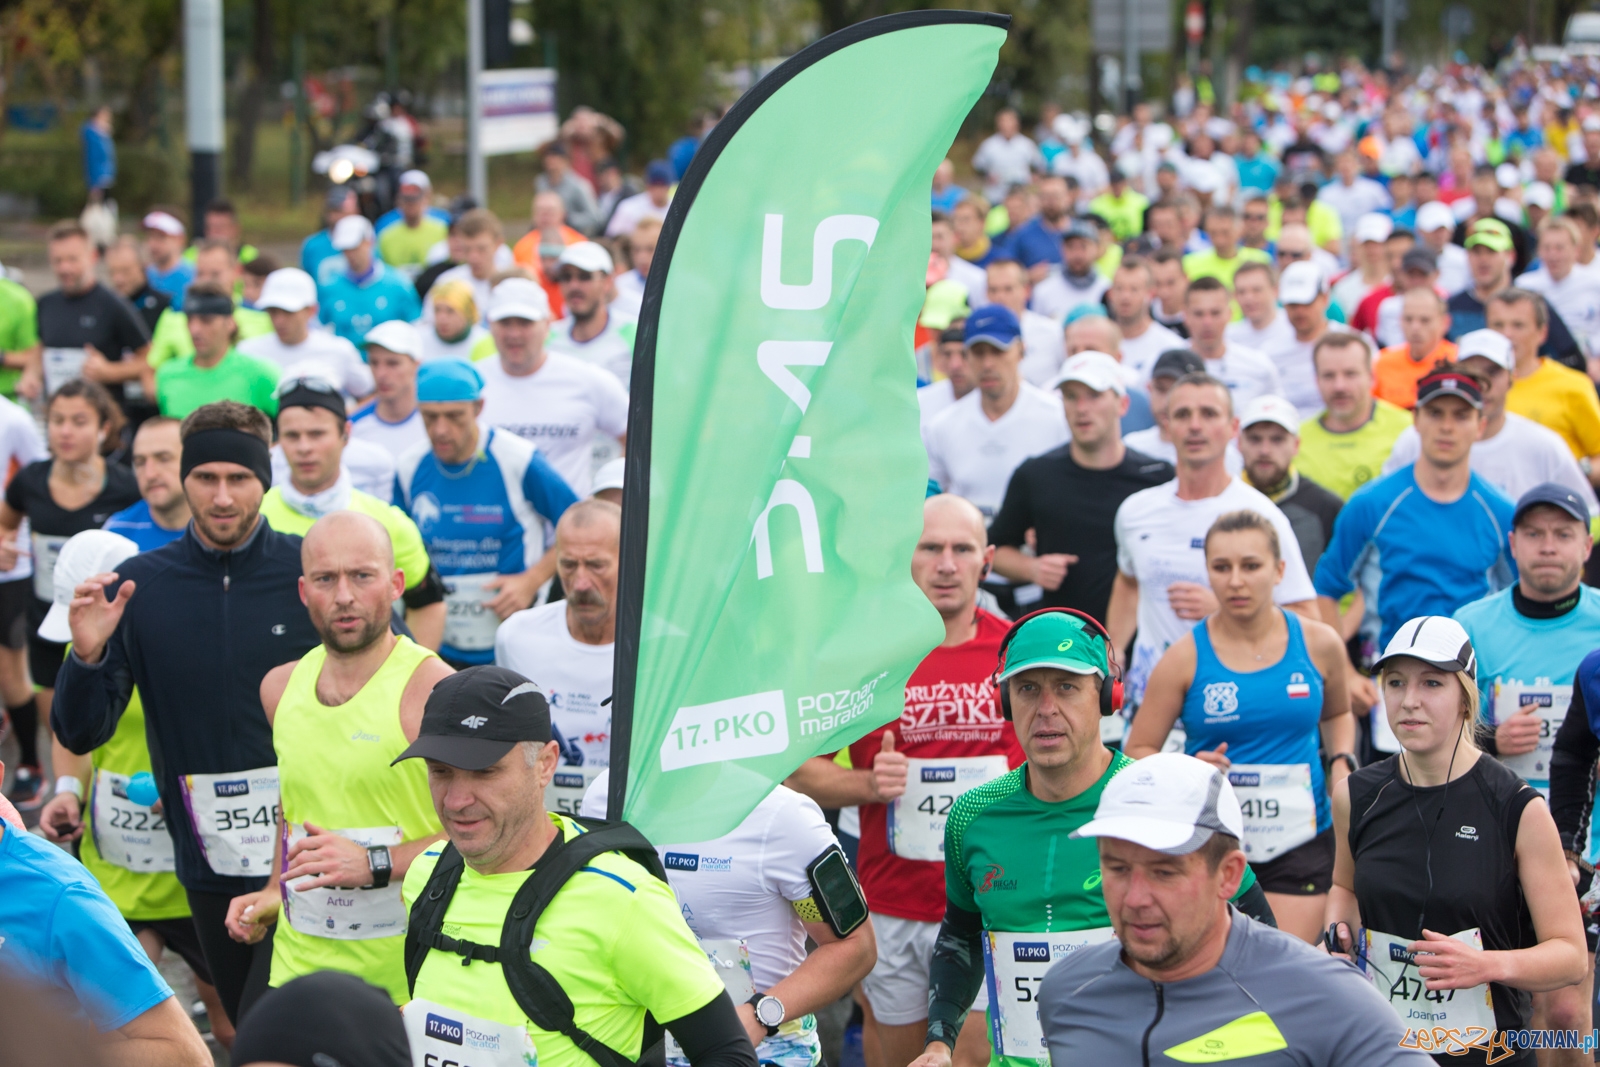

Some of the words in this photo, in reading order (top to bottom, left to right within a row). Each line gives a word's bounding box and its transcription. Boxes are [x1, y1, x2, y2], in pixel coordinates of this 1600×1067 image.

[800, 692, 874, 736] maraton
[461, 715, 489, 729] 4F
[240, 835, 270, 845] Jakub
[326, 896, 354, 907] Artur
[1406, 1008, 1447, 1021] Joanna
